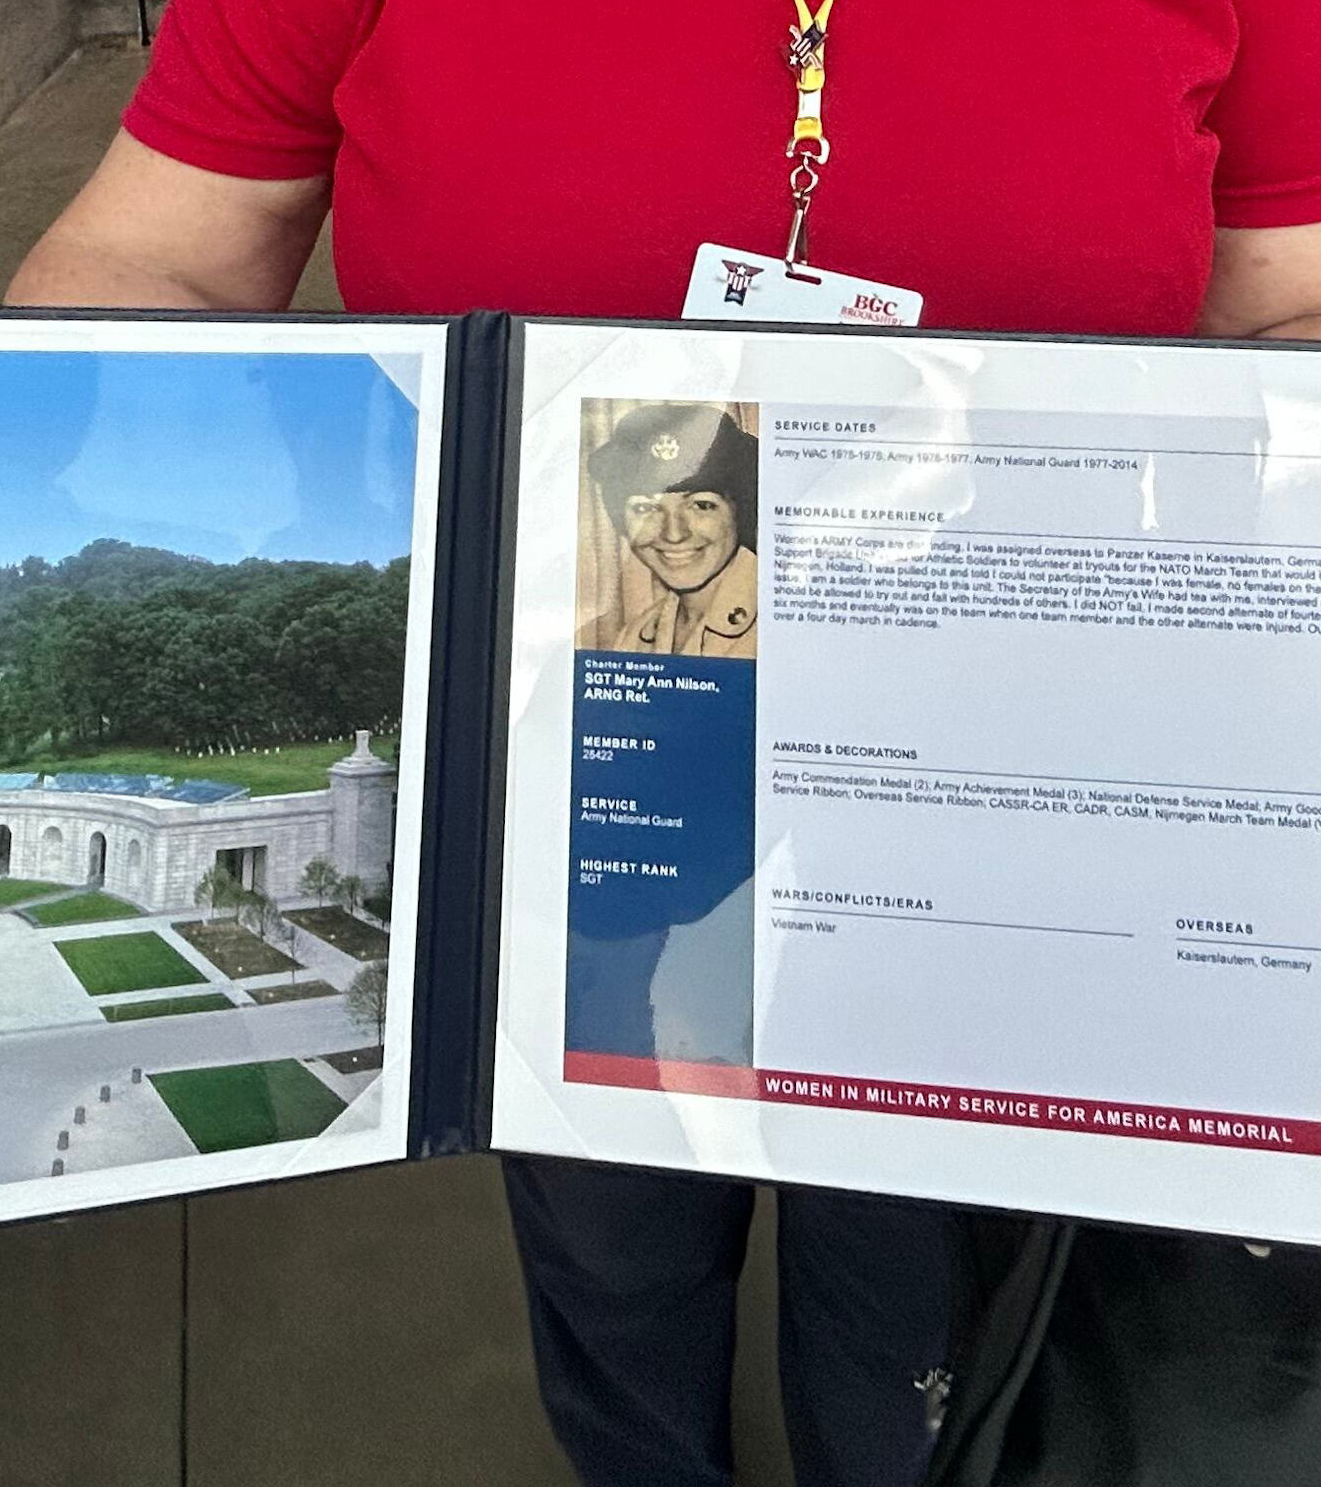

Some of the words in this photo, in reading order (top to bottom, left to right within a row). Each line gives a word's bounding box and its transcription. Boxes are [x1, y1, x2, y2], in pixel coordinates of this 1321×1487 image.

[854, 294, 898, 316] BGC
[774, 420, 830, 432] SERVICE
[834, 421, 876, 433] DATES
[802, 448, 828, 459] WAC
[1083, 456, 1141, 468] 1977-2014
[773, 506, 856, 518] MEMORABLE
[860, 509, 944, 521] EXPERIENCE
[584, 659, 622, 669] Charter
[624, 661, 664, 671] Member
[584, 672, 610, 684] SGT
[613, 674, 645, 689] Mary
[646, 676, 673, 688] Ann
[583, 688, 622, 701] ARNG
[625, 691, 650, 702] Ret.
[582, 736, 638, 749] MEMBER
[641, 739, 656, 750] ID
[772, 742, 821, 755] AWARDS
[824, 744, 832, 755] &
[834, 745, 918, 759] DECORATIONS
[772, 770, 798, 784] Army
[800, 771, 877, 786] Commendation
[879, 776, 912, 788] Medal
[932, 780, 961, 794] Army
[962, 781, 1030, 795] Achievement
[1032, 786, 1065, 797] Medal
[1087, 789, 1132, 802] National
[1134, 792, 1179, 804] Defense
[1181, 795, 1222, 807] Service
[1263, 800, 1292, 814] Army
[581, 797, 637, 810] SERVICE
[772, 784, 810, 797] Service
[853, 789, 903, 802] Overseas
[904, 792, 943, 805] Service
[1207, 811, 1243, 824] March
[1245, 813, 1275, 826] Team
[1276, 815, 1312, 828] Medal
[580, 812, 607, 826] Army
[608, 813, 650, 825] National
[651, 815, 683, 827] Guard
[579, 859, 636, 872] HIGHEST
[640, 863, 677, 875] RANK
[579, 873, 602, 883] SGT
[772, 889, 933, 909] WARS/CONFLICTS/ERAS
[771, 918, 813, 931] Vietnam
[815, 921, 836, 932] War
[1175, 918, 1253, 934] OVERSEAS
[1260, 955, 1312, 971] Germany
[765, 1078, 833, 1098] WOMEN
[840, 1085, 858, 1101] IN
[865, 1088, 950, 1109] MILITARY
[958, 1096, 1039, 1118] SERVICE
[1047, 1105, 1085, 1122] FOR
[1092, 1109, 1180, 1131] AMERICA
[1188, 1118, 1292, 1142] MEMORIAL
